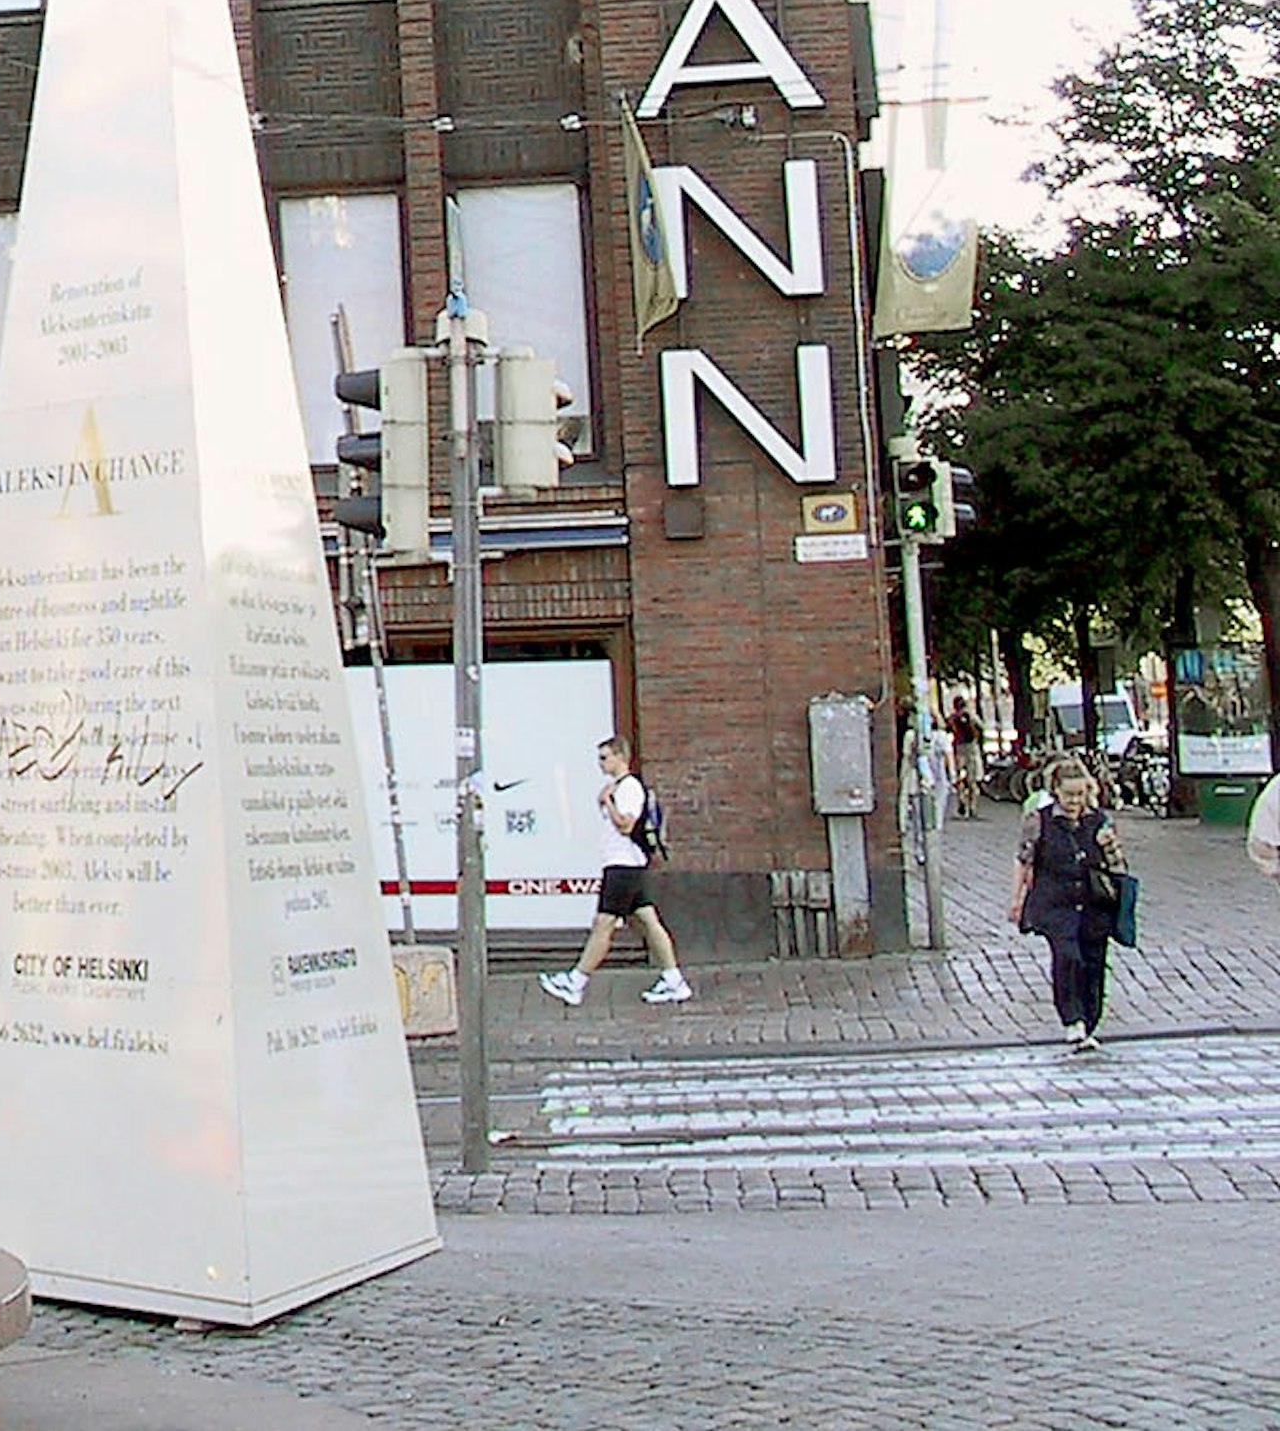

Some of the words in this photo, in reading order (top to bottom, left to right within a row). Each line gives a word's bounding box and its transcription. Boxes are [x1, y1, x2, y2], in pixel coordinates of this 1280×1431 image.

[68, 460, 91, 487] IN
[94, 448, 187, 483] CHANGE
[163, 552, 187, 577] the
[100, 590, 127, 614] and
[129, 585, 188, 617] nightlife
[15, 627, 69, 653] Helsinki
[77, 658, 111, 683] good
[146, 654, 162, 678] of
[164, 653, 191, 677] this
[75, 693, 122, 717] During
[124, 690, 147, 712] the
[150, 694, 181, 712] next
[104, 791, 131, 814] and
[55, 824, 94, 847] When
[96, 825, 169, 853] completed
[171, 825, 189, 856] by
[125, 859, 153, 882] will
[154, 859, 174, 883] be
[507, 879, 562, 895] ONE
[11, 889, 53, 915] better
[55, 890, 86, 915] than
[13, 952, 49, 977] CITY
[52, 954, 74, 978] OF
[77, 955, 150, 982] HELSINKI
